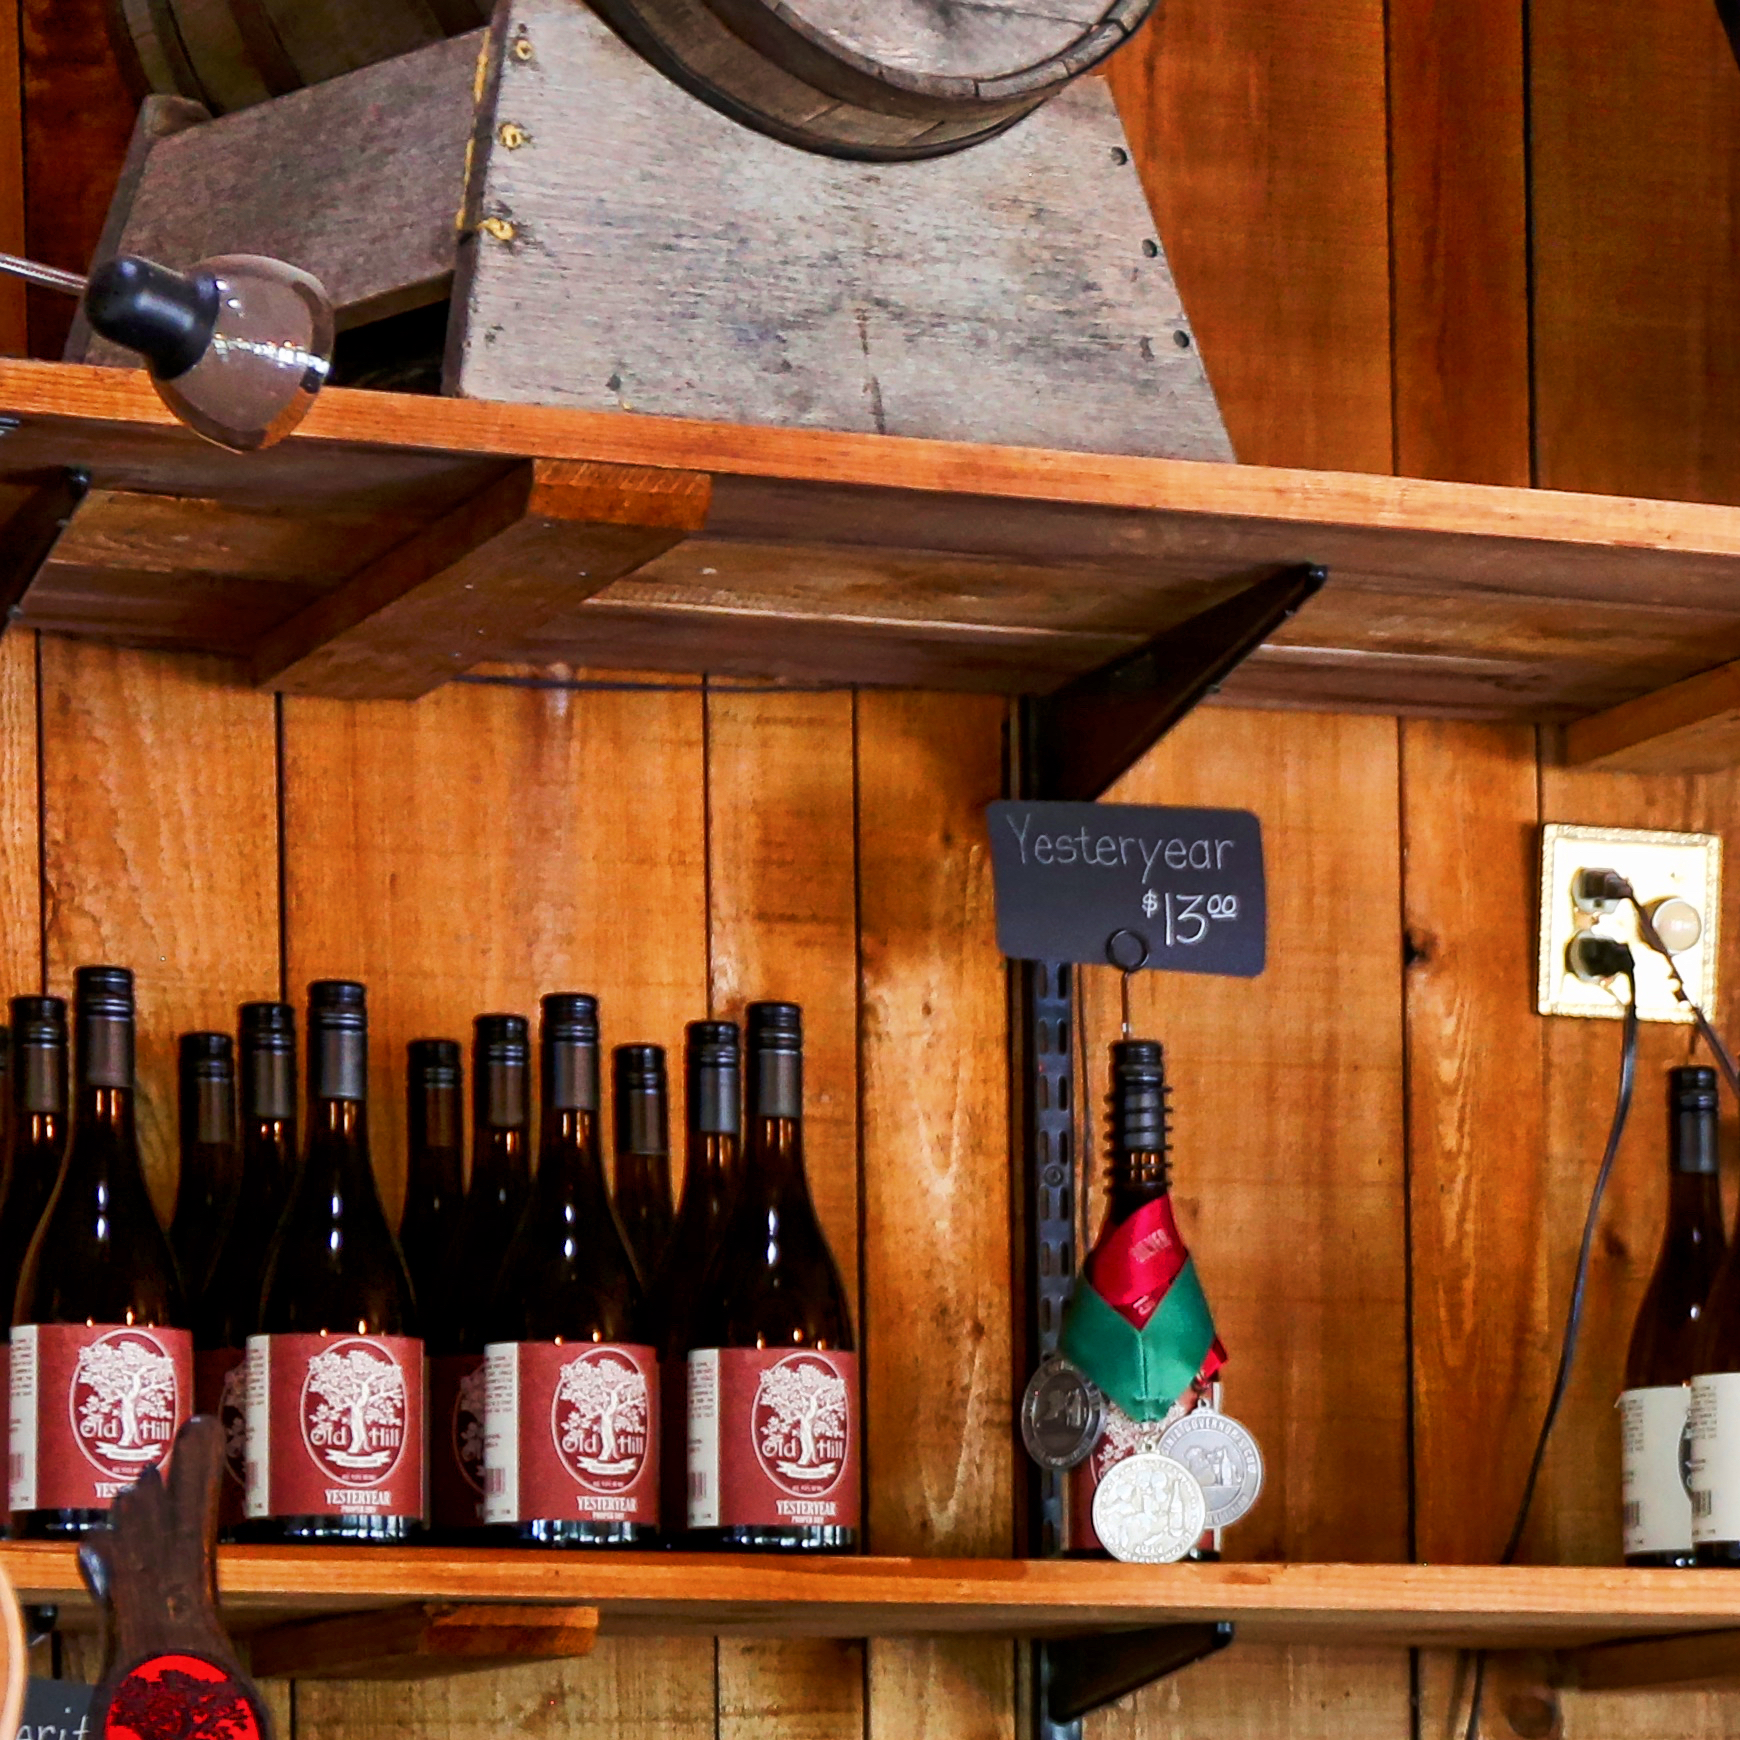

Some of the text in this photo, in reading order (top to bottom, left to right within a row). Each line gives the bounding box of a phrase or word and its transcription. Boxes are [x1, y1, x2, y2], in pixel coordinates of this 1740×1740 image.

[1005, 813, 1235, 884] Yesteryear
[80, 1415, 170, 1440] Old Hill
[310, 1424, 400, 1447] Old Hill
[562, 1432, 643, 1455] Old Hill
[762, 1437, 843, 1459] Old Hill
[325, 1489, 392, 1506] YESTERYEAR
[576, 1495, 638, 1512] YESTERYEAR
[775, 1499, 837, 1515] YESTERYEAR
